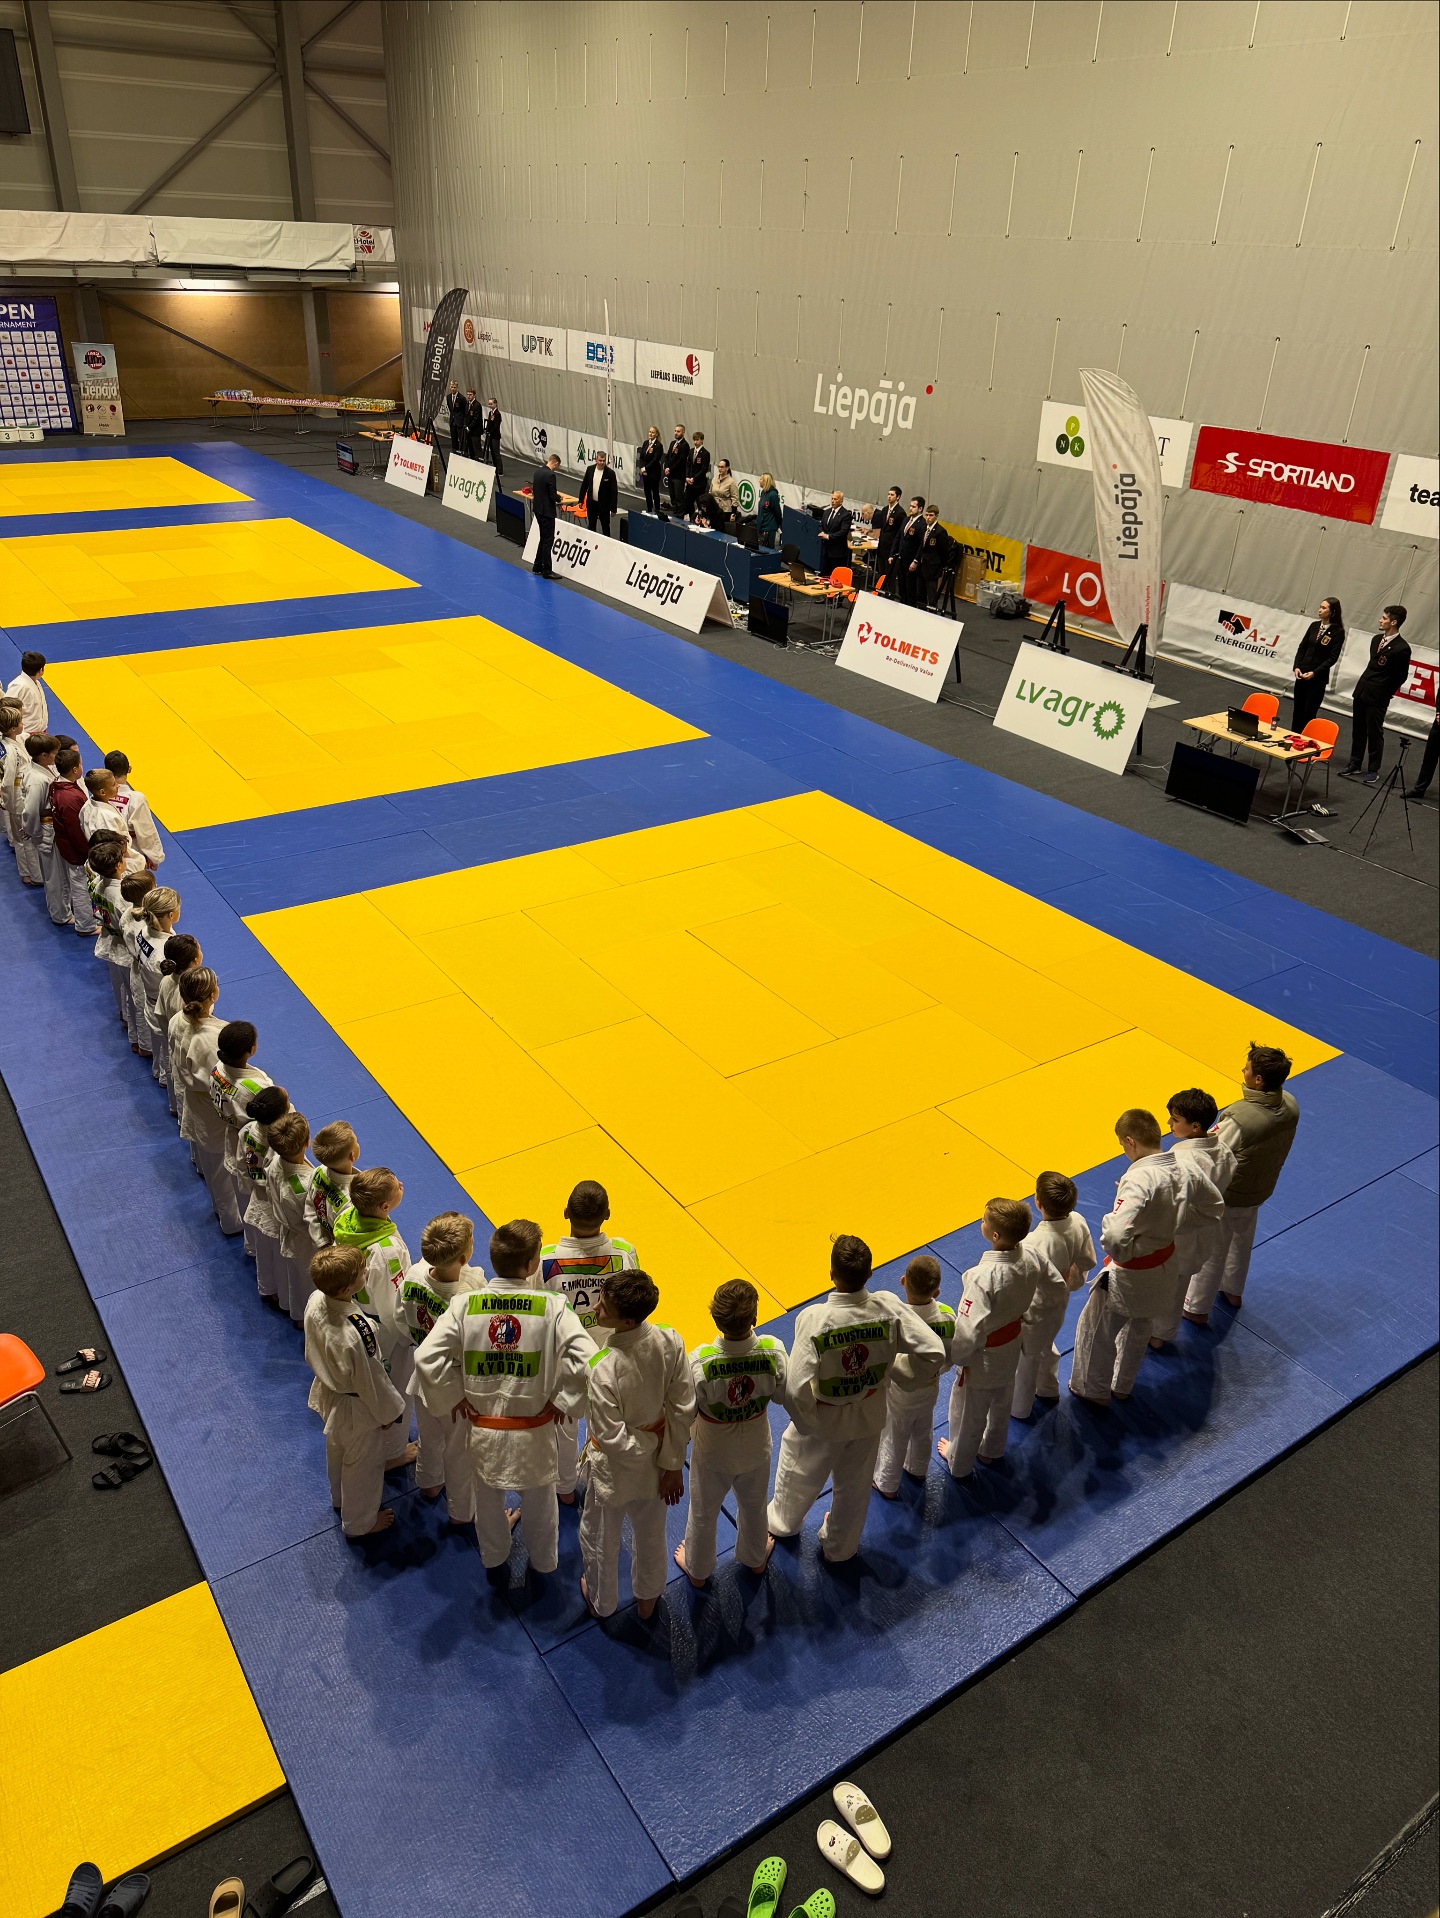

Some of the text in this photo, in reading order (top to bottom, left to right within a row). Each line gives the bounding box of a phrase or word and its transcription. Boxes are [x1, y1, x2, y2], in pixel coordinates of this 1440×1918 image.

[521, 333, 554, 357] UPTK
[813, 372, 918, 437] Liepāja
[399, 457, 425, 474] TOLMETS
[1246, 458, 1356, 493] SPORTLAND
[1115, 472, 1144, 560] Liepāja
[551, 530, 592, 569] epāja
[625, 561, 685, 606] Liepāja
[873, 631, 940, 666] TOLMETS
[1214, 634, 1278, 659] ENERGOBŪVE
[1244, 628, 1281, 648] A-J
[885, 655, 934, 677] Re-Delivering Value
[477, 1361, 532, 1377] KYODAI
[485, 1352, 524, 1363] JUDO CLUB
